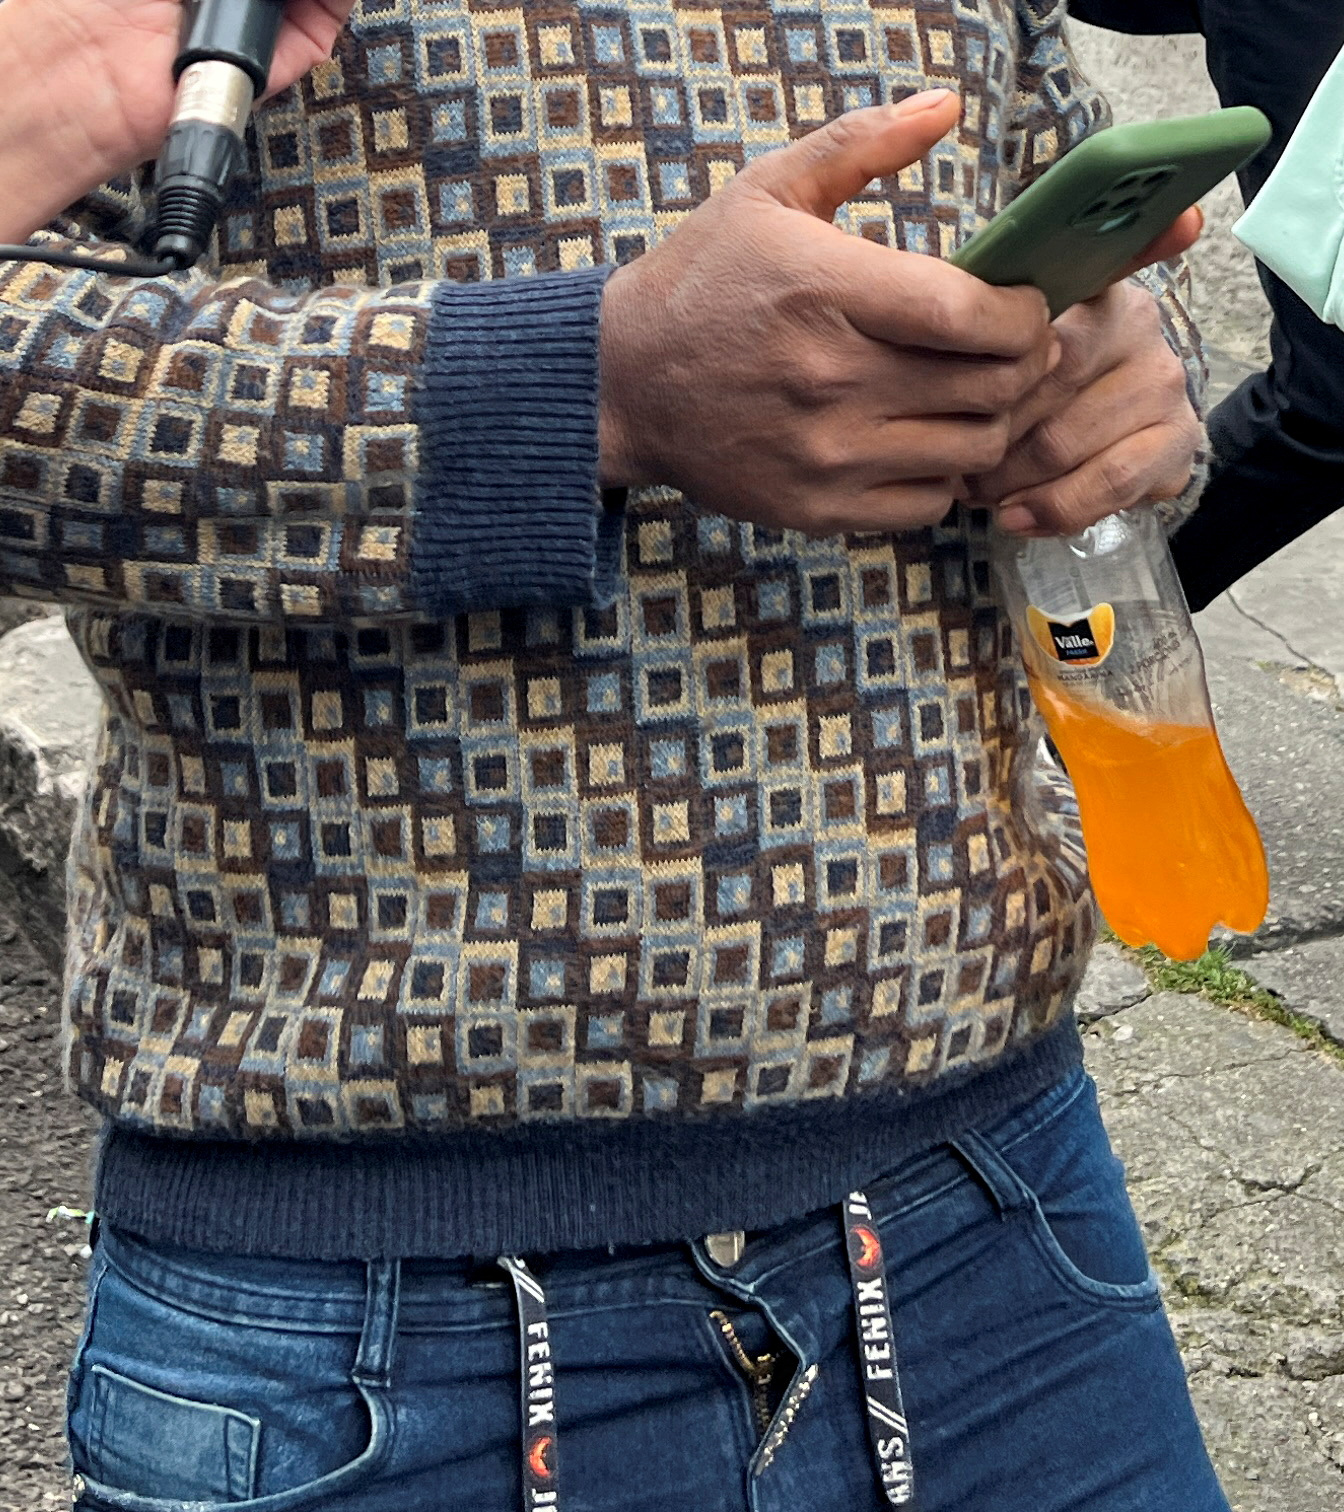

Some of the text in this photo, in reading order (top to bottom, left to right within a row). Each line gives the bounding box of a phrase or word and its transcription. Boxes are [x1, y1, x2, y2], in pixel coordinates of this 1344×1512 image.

[1054, 634, 1092, 650] Valle
[527, 1321, 555, 1427] FENIX
[857, 1277, 893, 1381] FENIX
